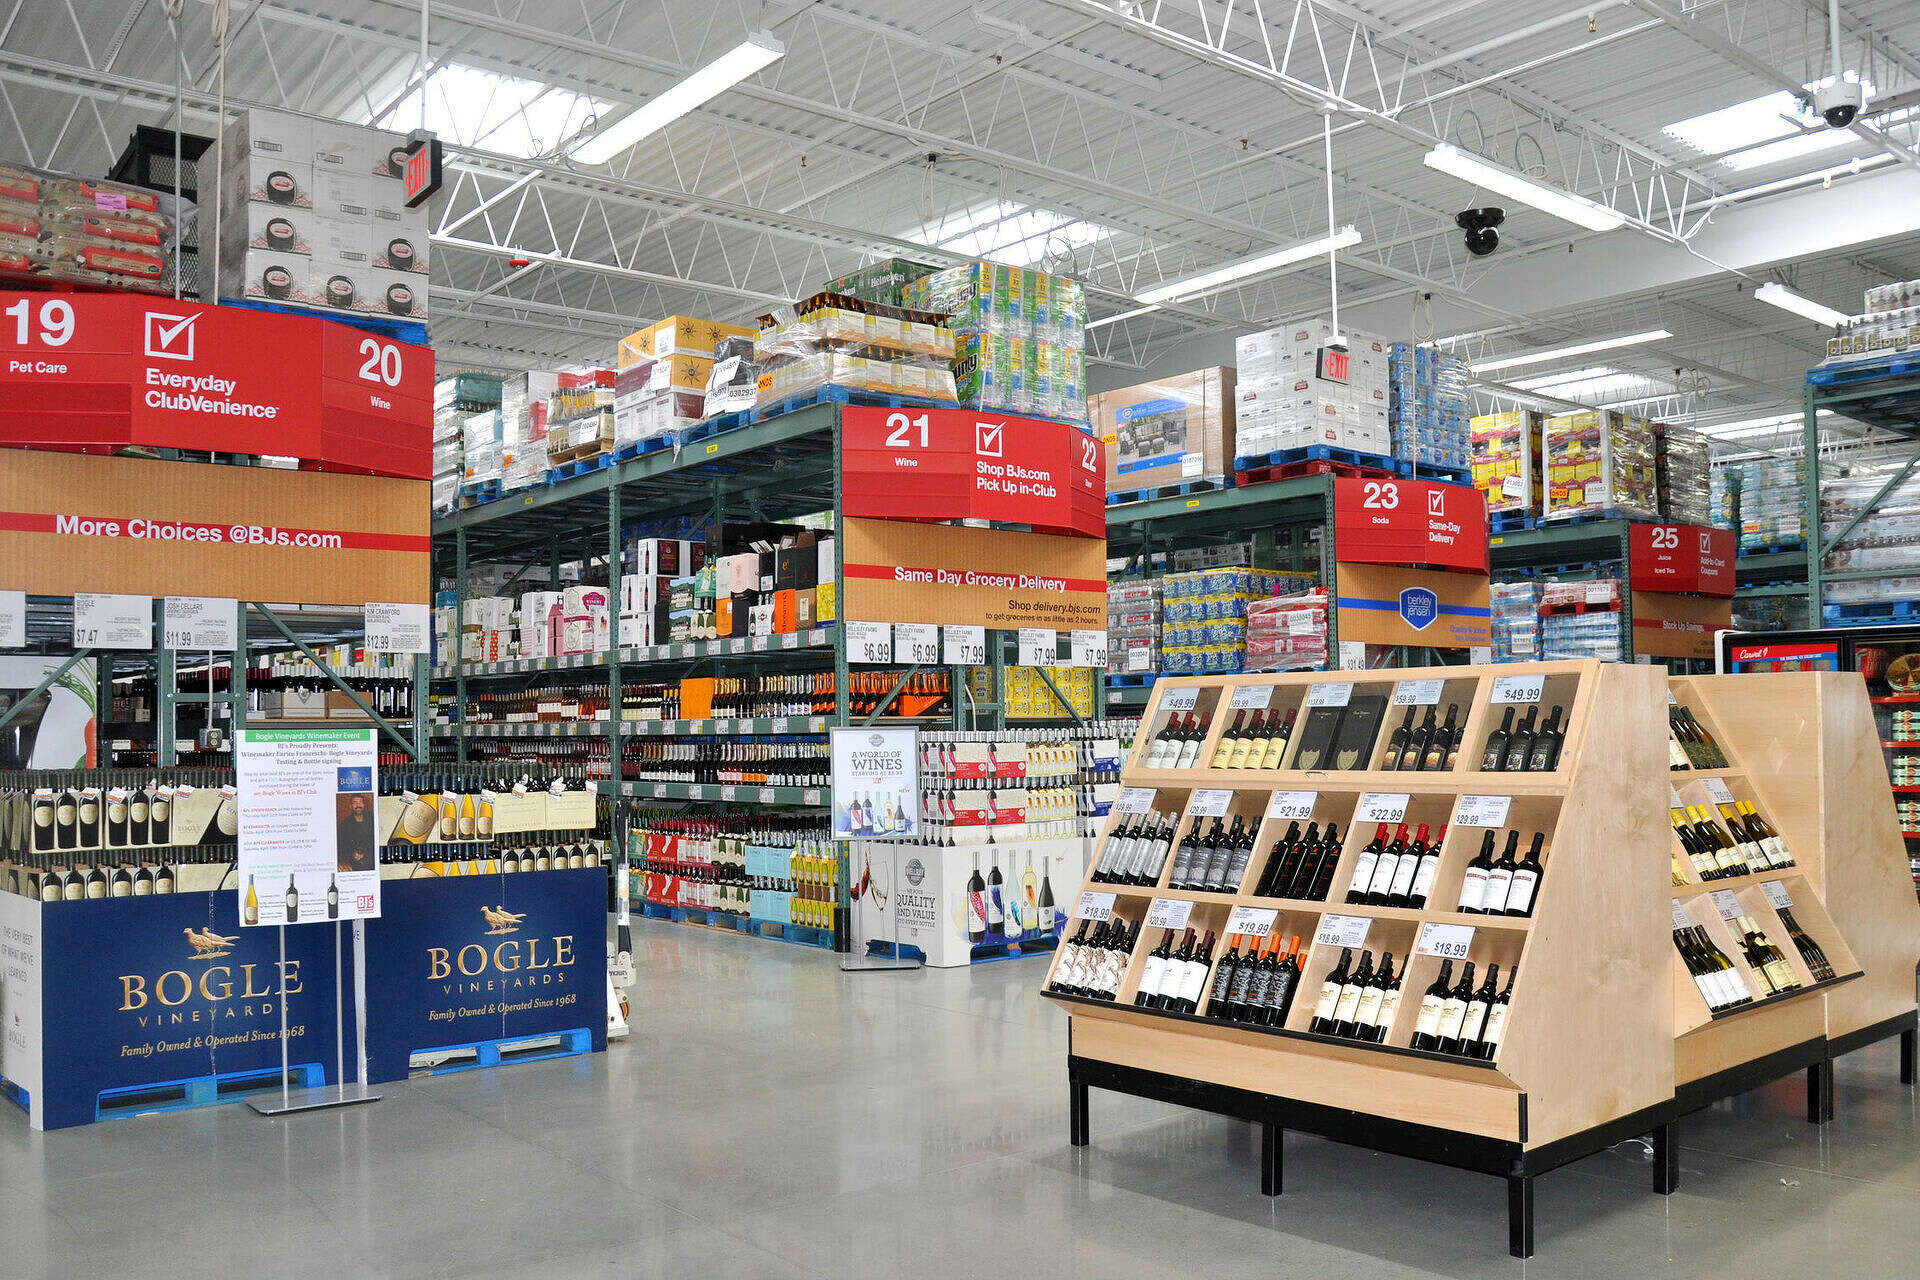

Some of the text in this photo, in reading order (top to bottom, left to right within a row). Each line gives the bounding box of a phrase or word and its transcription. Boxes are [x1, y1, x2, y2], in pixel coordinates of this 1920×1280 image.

[408, 148, 428, 197] EXIT
[871, 273, 904, 287] Heineken
[6, 299, 75, 346] 19
[10, 361, 67, 374] Pet Care
[358, 338, 402, 387] 20
[1329, 352, 1350, 381] EXIT
[146, 368, 236, 396] Everyday
[145, 391, 277, 419] ClubVenience
[371, 395, 391, 410] Wine
[885, 412, 929, 447] 21
[895, 457, 918, 467] Wine
[1082, 437, 1096, 473] 22
[977, 460, 1050, 482] Shop BJs.com
[977, 477, 1057, 498] Pick Up in-Club
[1363, 482, 1399, 509] 23
[1372, 516, 1390, 525] Soda
[1429, 519, 1461, 534] Same-Day
[57, 515, 342, 549] More Choices @BJs.com
[1429, 532, 1454, 546] Delivery
[1652, 527, 1679, 549] 25
[895, 566, 1066, 593] Same Day Grocery Delivery
[1008, 599, 1100, 615] Shop delivery.bjs.com
[1407, 594, 1432, 607] berkley
[993, 614, 1005, 622] get
[1006, 614, 1035, 623] groceries
[1052, 615, 1066, 623] little
[1075, 616, 1080, 624] 2
[1407, 606, 1431, 617] jensen
[1662, 620, 1677, 630] Stock
[1678, 622, 1686, 631] Up
[76, 629, 98, 645] $7.47
[166, 631, 192, 647] $11.99
[367, 635, 389, 649] $12.99
[864, 643, 890, 662] $6.99
[912, 643, 937, 663] $6.99
[961, 645, 984, 664] $7.99
[1034, 647, 1056, 666] $7.99
[1085, 648, 1107, 666] $7.99
[1740, 648, 1762, 659] Carvel
[1504, 688, 1540, 700] $49.99
[1169, 698, 1195, 709] $49.99
[275, 732, 305, 740] Vineyards
[852, 759, 903, 770] WINES
[1280, 806, 1311, 818] $21.99
[1370, 809, 1403, 820] $22.99
[1456, 815, 1479, 825] $29.99
[357, 894, 375, 909] BJ's
[912, 909, 935, 920] VALUE
[1085, 907, 1109, 919] $18.99
[1238, 922, 1269, 935] $19.99
[1319, 933, 1340, 944] $18.99
[1434, 941, 1467, 956] $18.99
[426, 935, 576, 980] BOGLE
[118, 960, 303, 1011] BOGLE
[444, 972, 565, 995] VINEYARDS
[139, 1003, 290, 1027] VINEYARDS
[429, 993, 577, 1022] Family Owned & Operated Since 1968
[121, 1025, 305, 1058] Family Owned & Operated Since 1968
